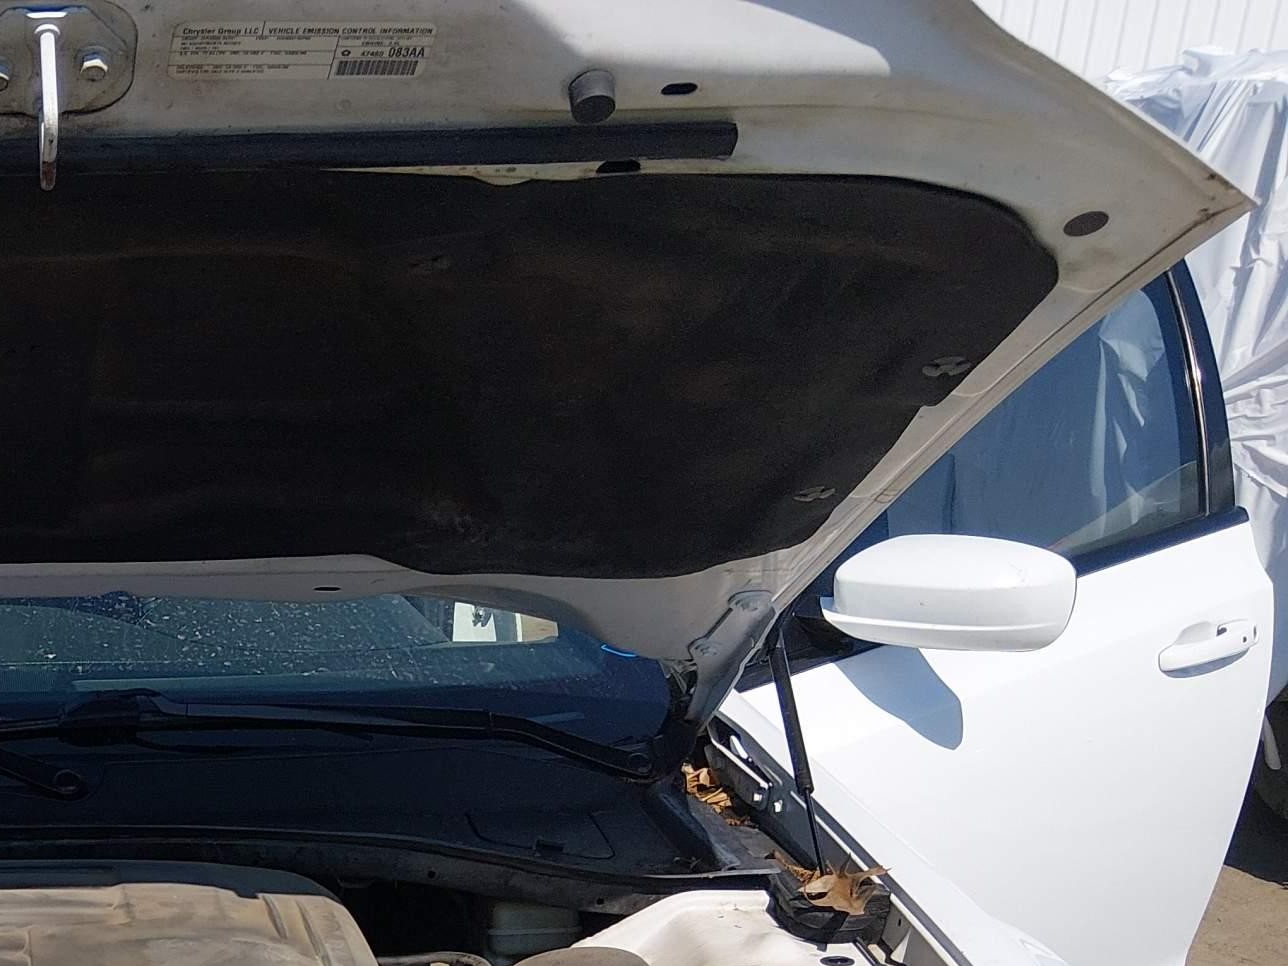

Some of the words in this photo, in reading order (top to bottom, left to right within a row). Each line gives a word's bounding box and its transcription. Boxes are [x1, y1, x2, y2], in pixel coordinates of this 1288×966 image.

[183, 27, 216, 36] Chrysler
[218, 27, 241, 36] Group
[244, 27, 259, 35] LLC
[268, 27, 300, 35] VEHICLE
[302, 27, 340, 35] EMISSION
[342, 27, 376, 35] CONTROL
[379, 27, 433, 35] INFORMATION
[387, 47, 425, 57] 083AA
